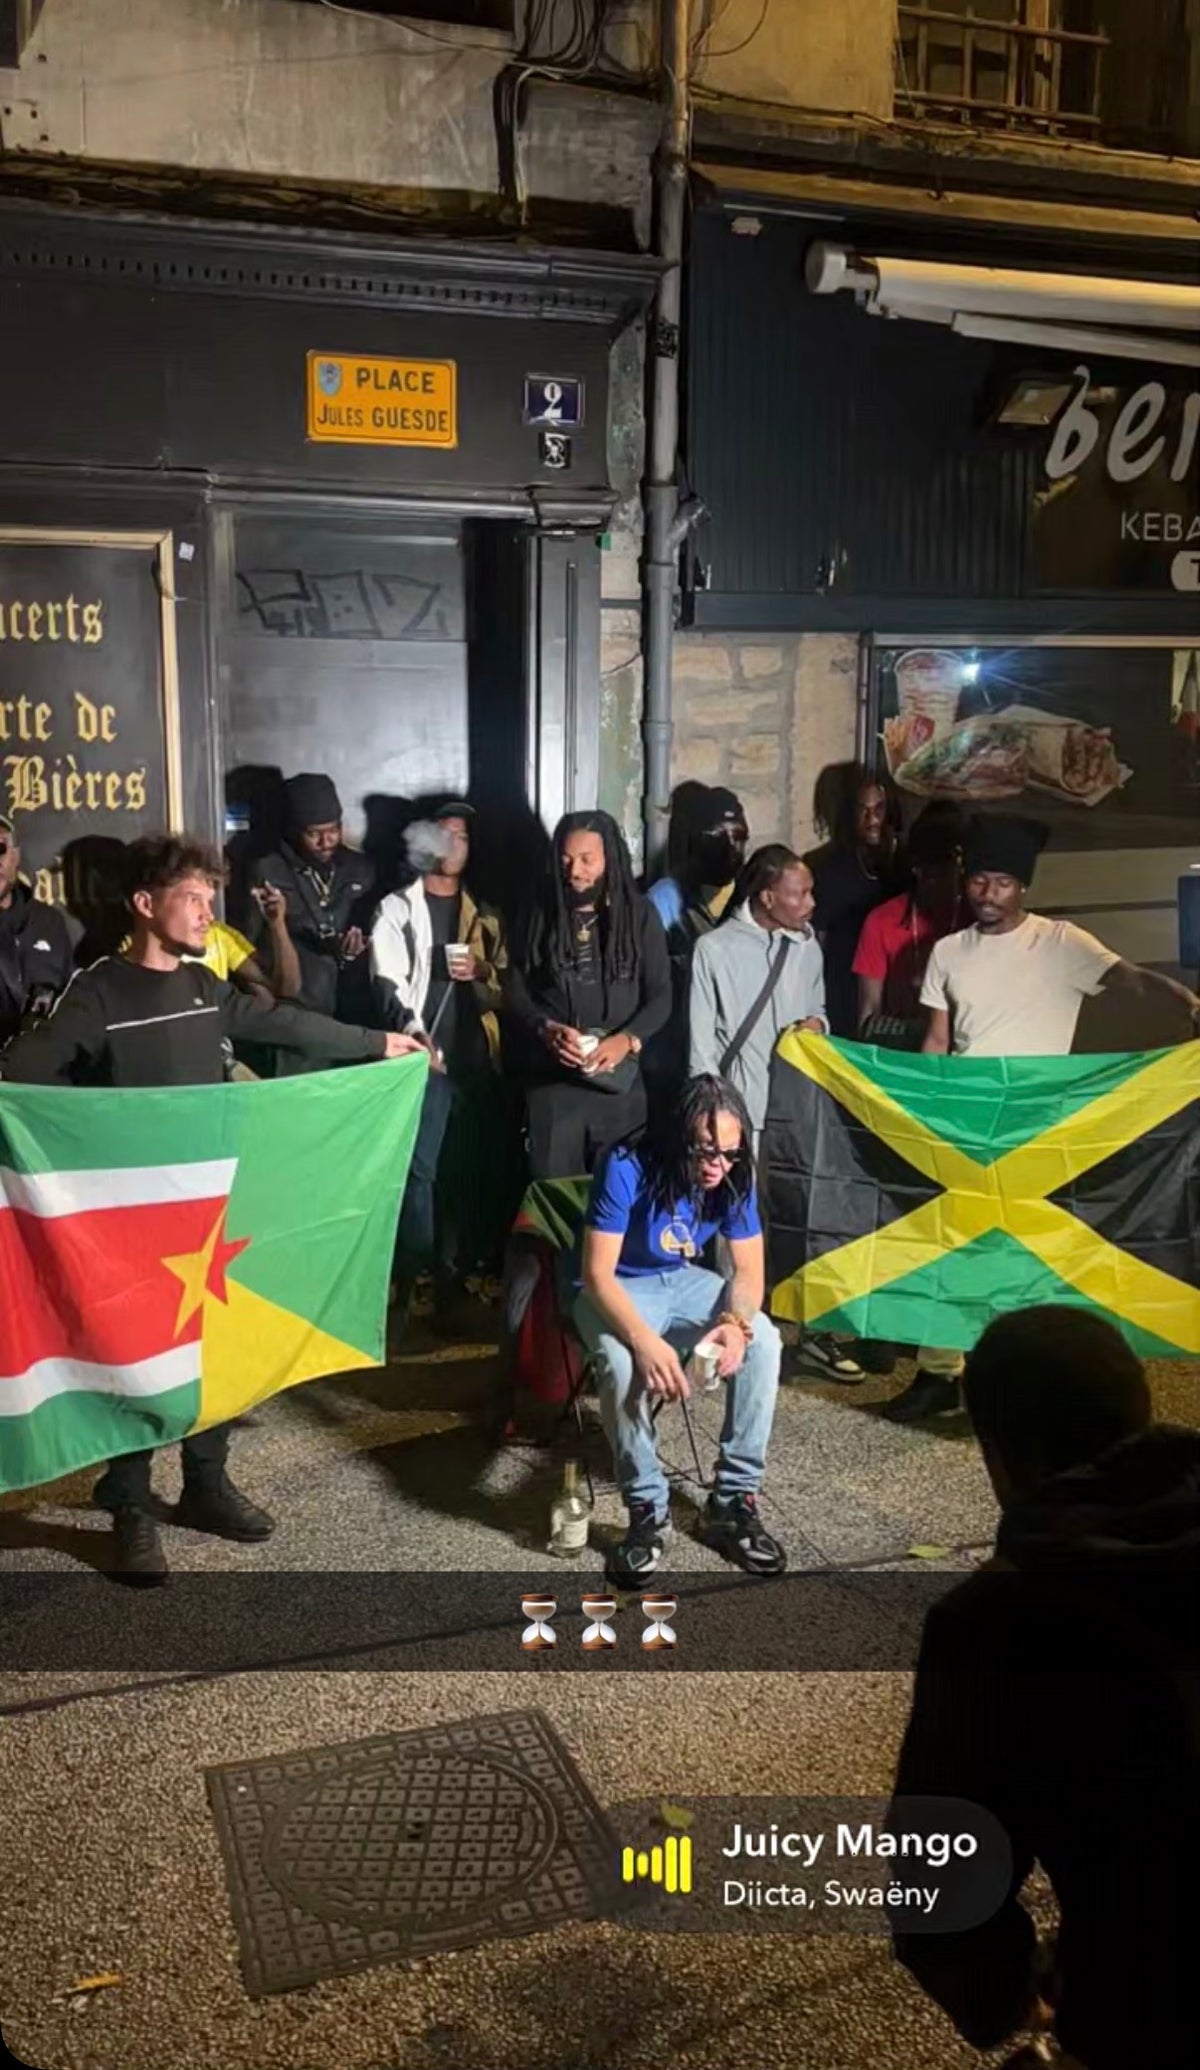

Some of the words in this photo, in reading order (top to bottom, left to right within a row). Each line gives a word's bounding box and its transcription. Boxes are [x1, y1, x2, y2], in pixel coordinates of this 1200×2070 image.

[356, 367, 436, 394] PLACE
[372, 407, 449, 433] GUESDE
[73, 691, 119, 742] de
[3, 753, 146, 819] Bières
